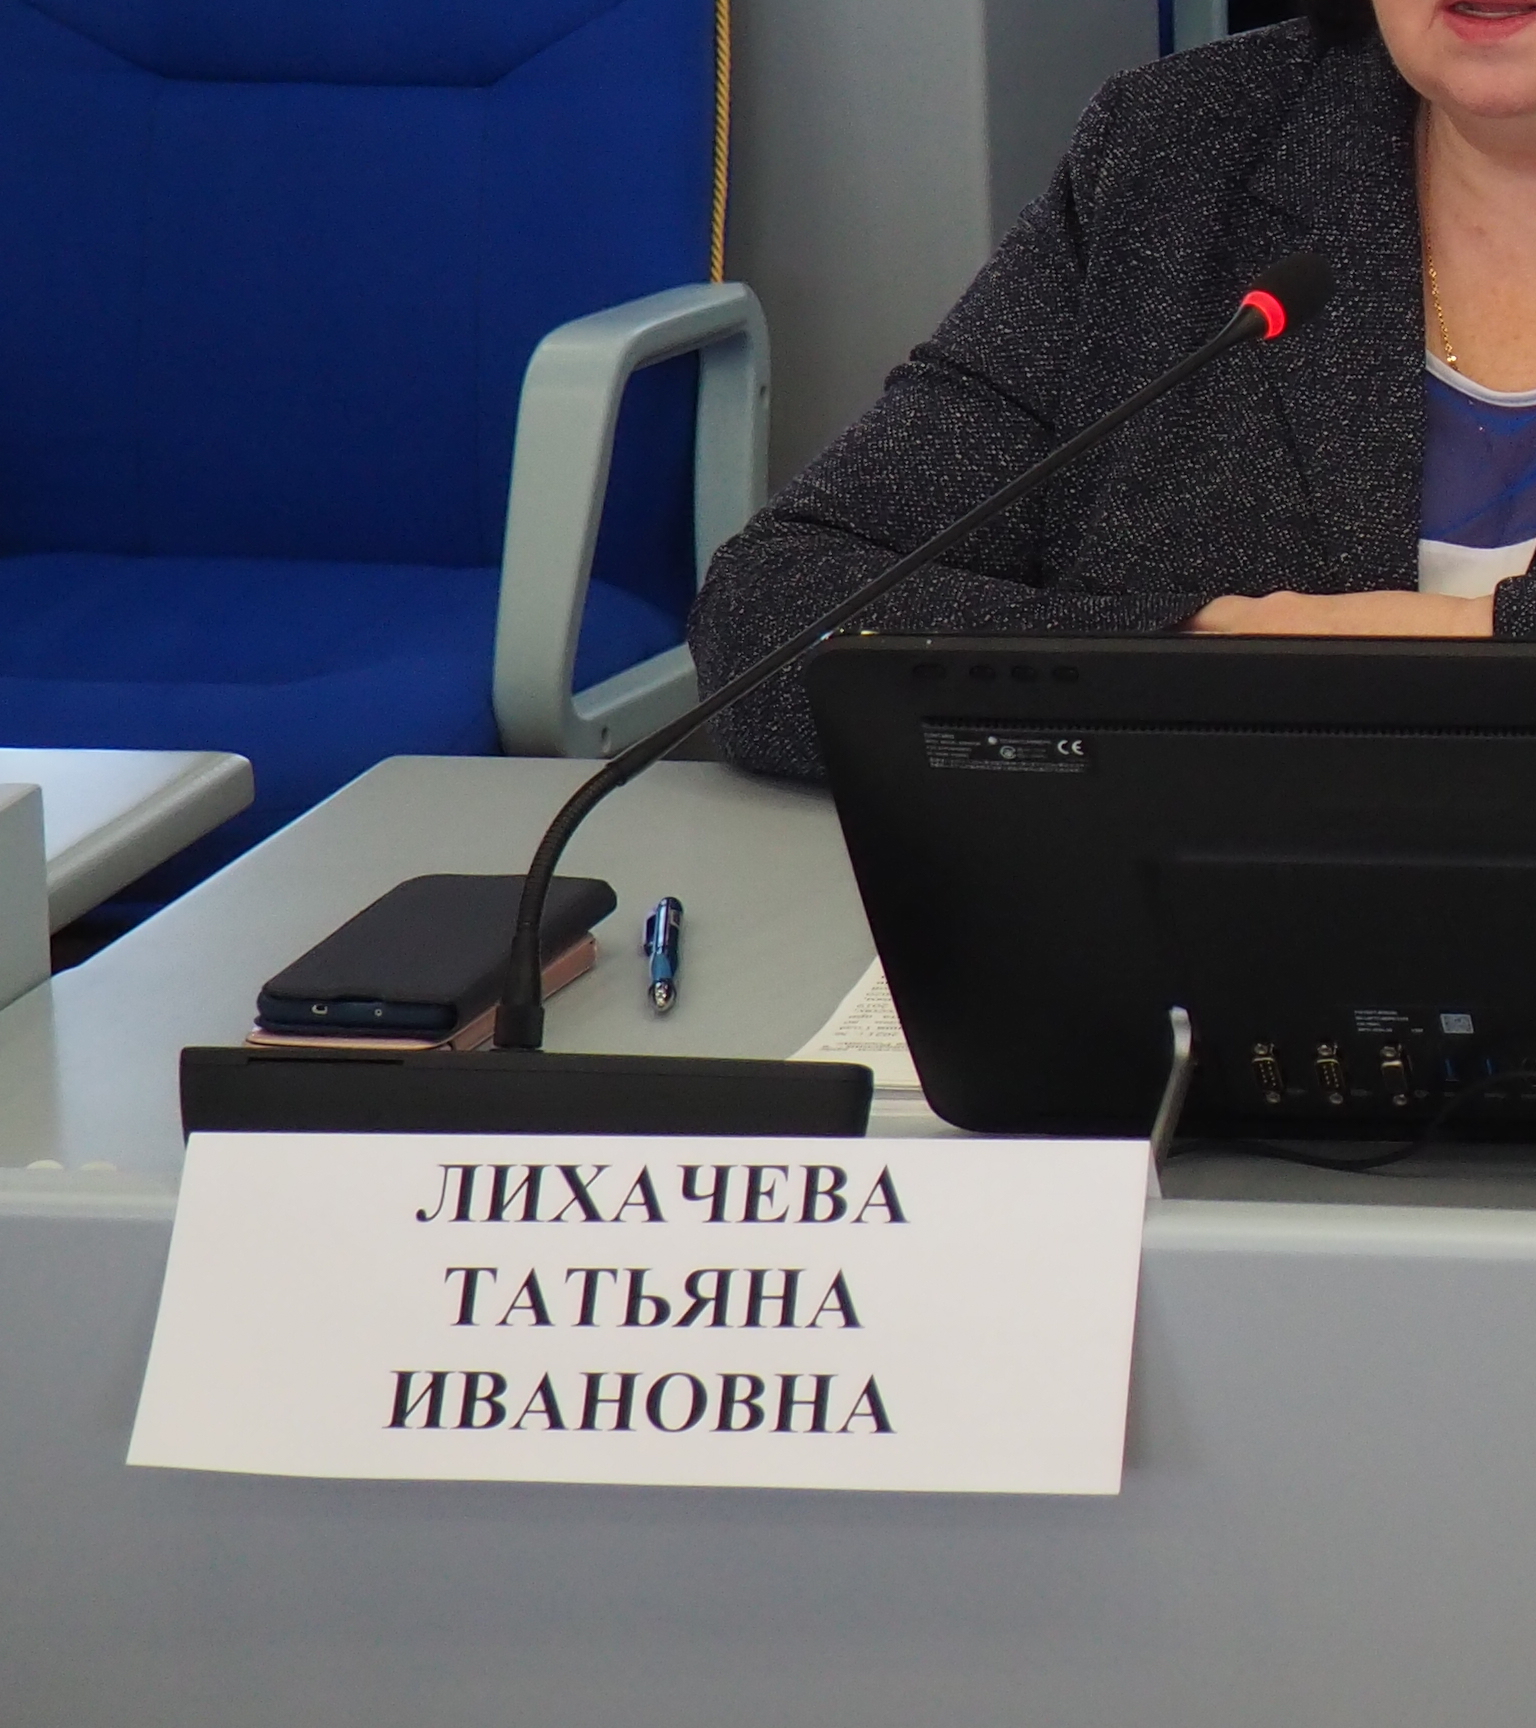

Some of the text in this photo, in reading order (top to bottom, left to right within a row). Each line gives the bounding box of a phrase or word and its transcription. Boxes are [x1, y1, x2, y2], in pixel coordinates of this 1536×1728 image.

[415, 1163, 909, 1224] ЛИХАЧЕВА
[444, 1267, 864, 1329] ТАТЬЯНА
[383, 1370, 897, 1435] ИВАНОВНА
